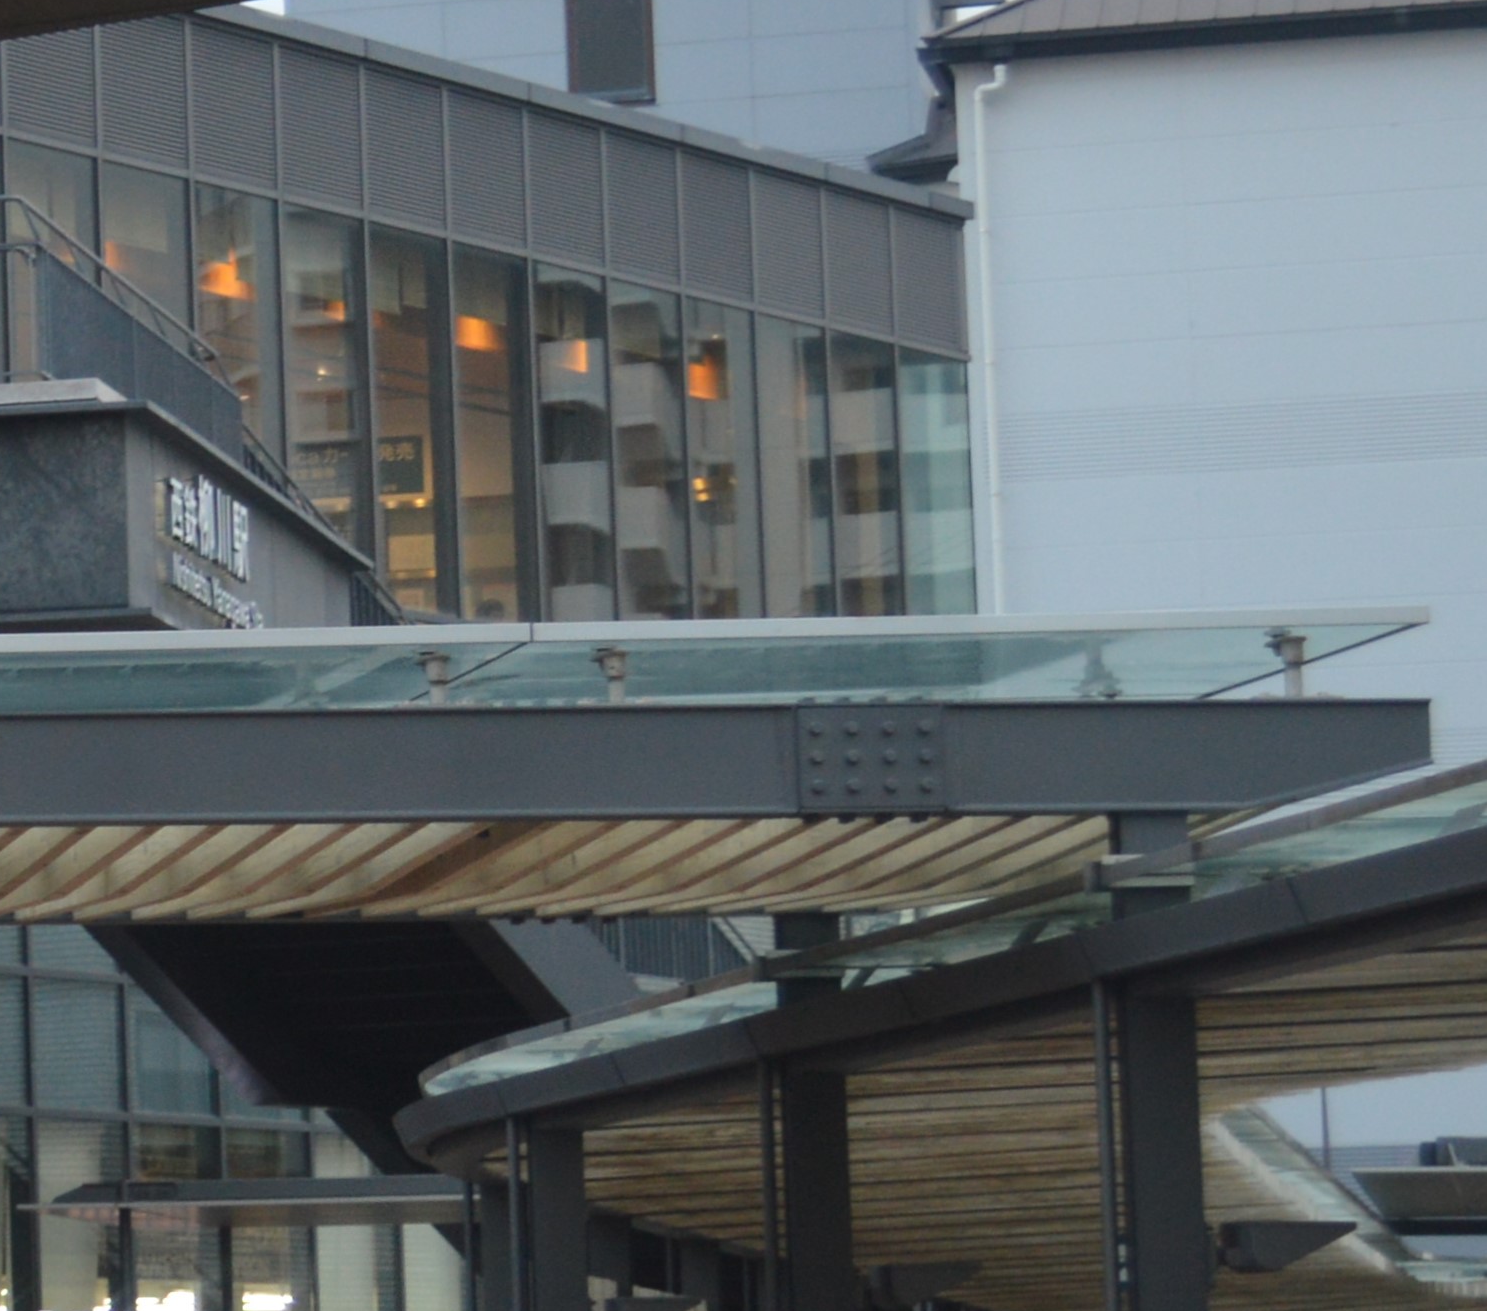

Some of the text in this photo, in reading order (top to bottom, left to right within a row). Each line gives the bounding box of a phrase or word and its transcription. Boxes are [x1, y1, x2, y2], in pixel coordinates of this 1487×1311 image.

[169, 474, 251, 583] 西鉄柳川駅
